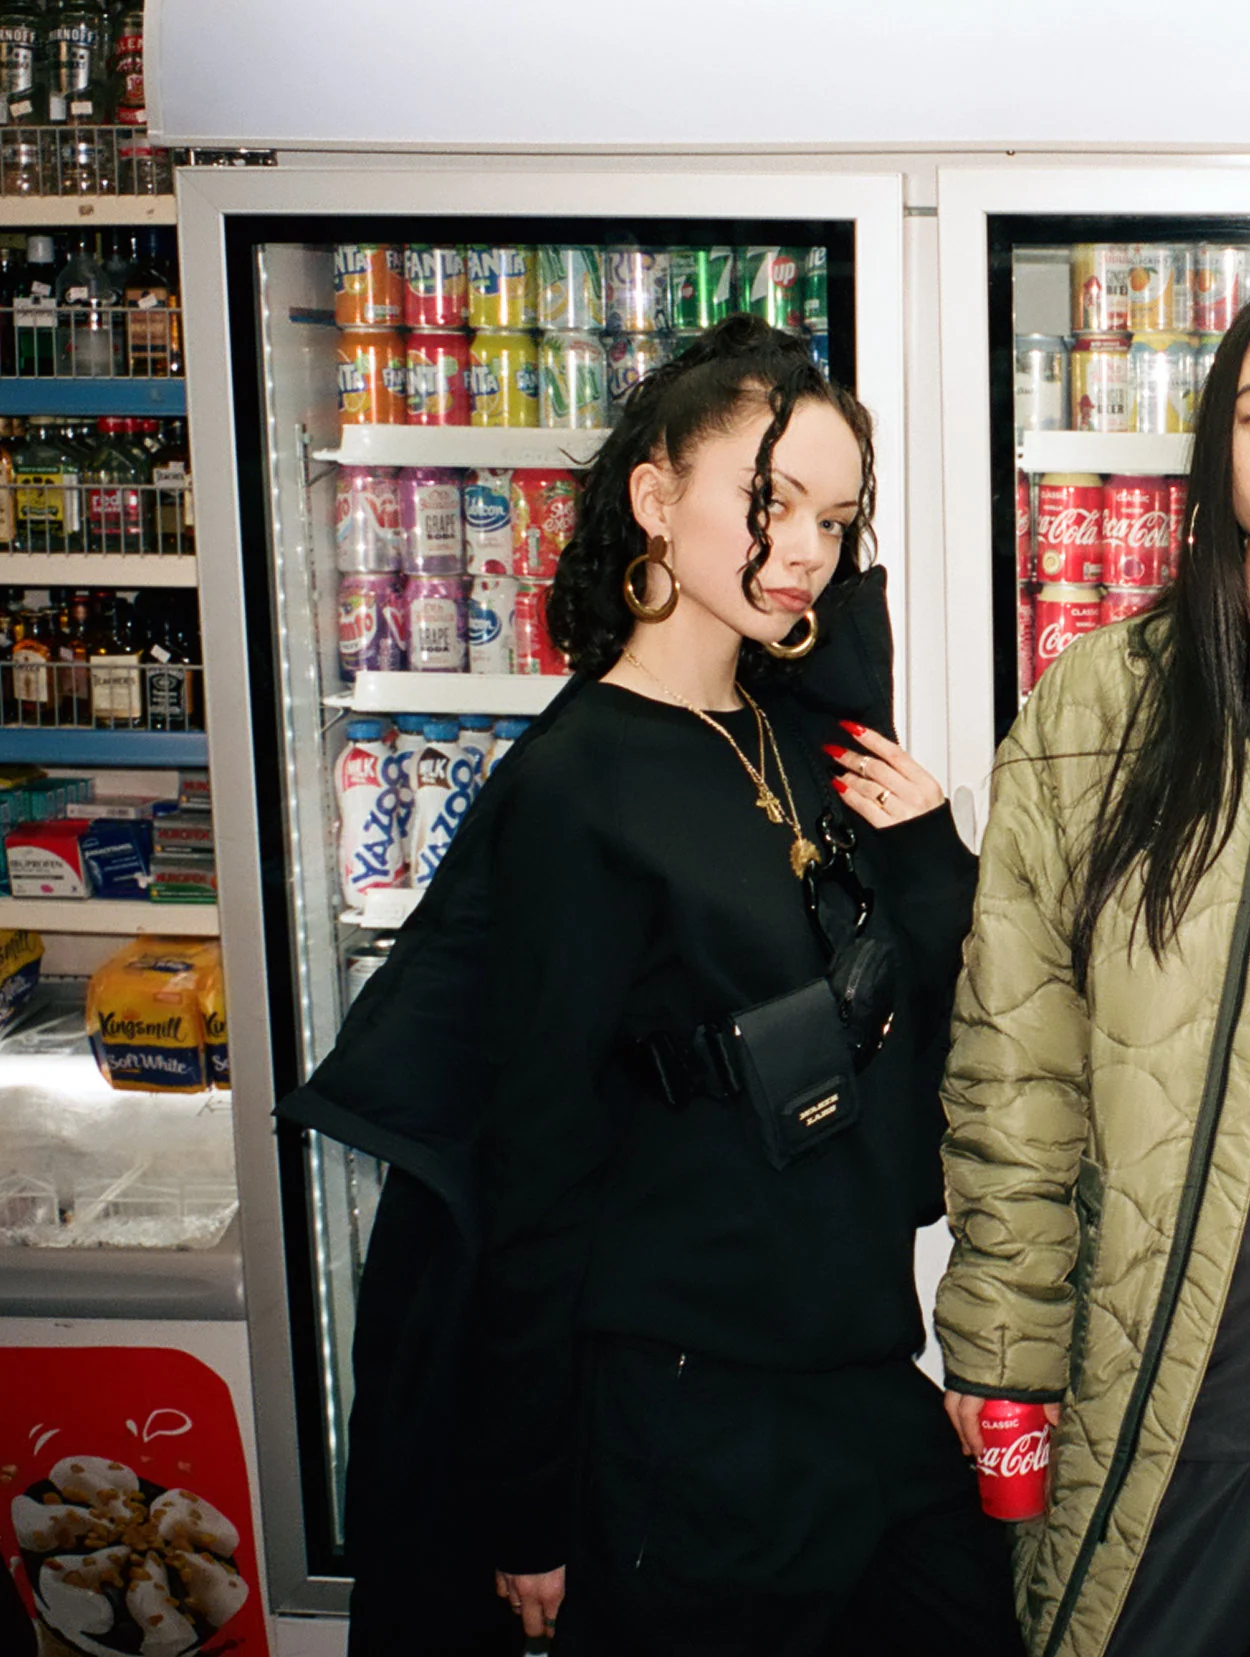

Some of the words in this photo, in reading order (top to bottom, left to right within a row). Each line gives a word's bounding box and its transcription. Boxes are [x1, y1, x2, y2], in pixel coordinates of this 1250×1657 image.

[0, 28, 36, 42] RNOFF
[98, 1011, 187, 1042] Kingsmill
[140, 1054, 188, 1075] White
[981, 1419, 1020, 1430] CLASSIC
